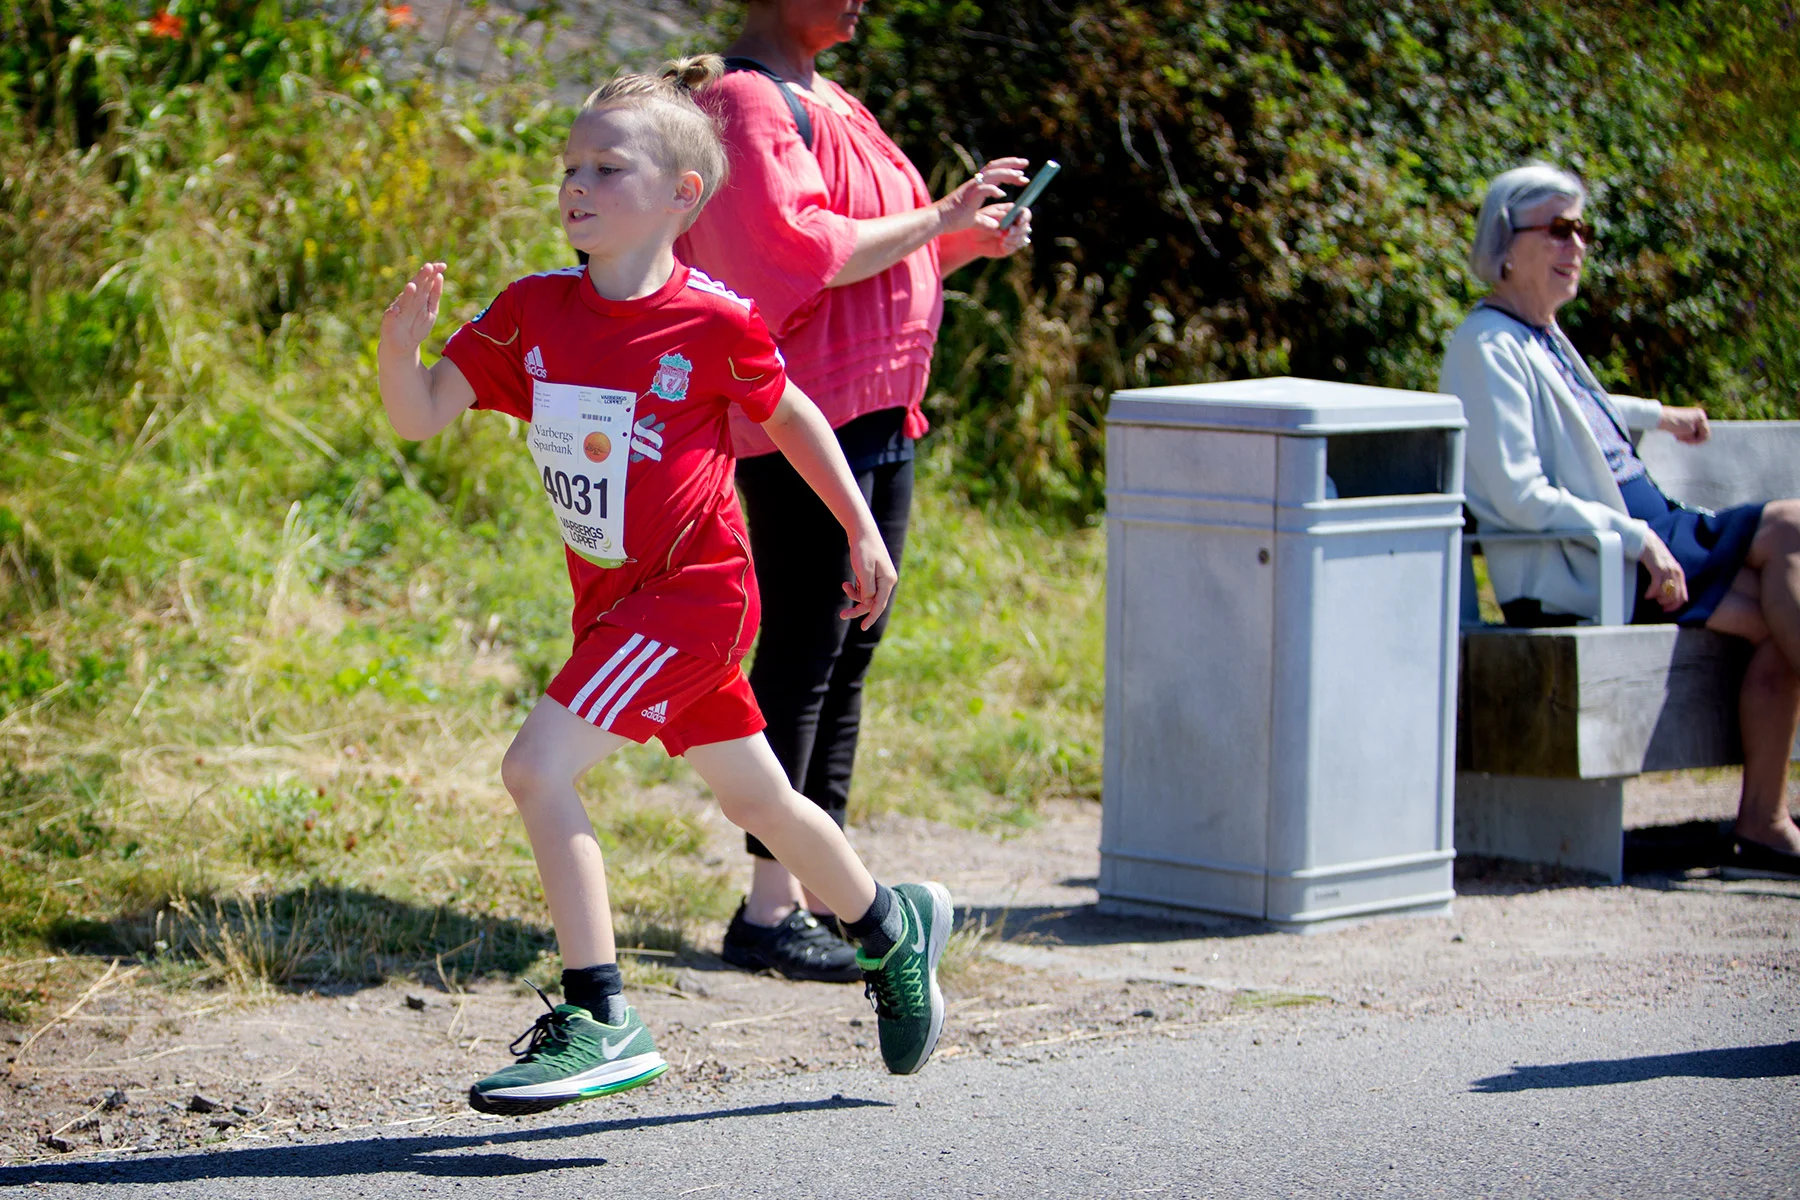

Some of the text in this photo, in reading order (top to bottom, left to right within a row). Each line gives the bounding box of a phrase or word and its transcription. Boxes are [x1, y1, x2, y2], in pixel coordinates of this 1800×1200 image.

[535, 424, 574, 443] Varbergs
[533, 438, 573, 455] Sparbank
[543, 466, 608, 519] 4031
[560, 516, 604, 540] VARBERGS
[569, 529, 598, 550] LOPPET
[641, 709, 666, 724] adidas
